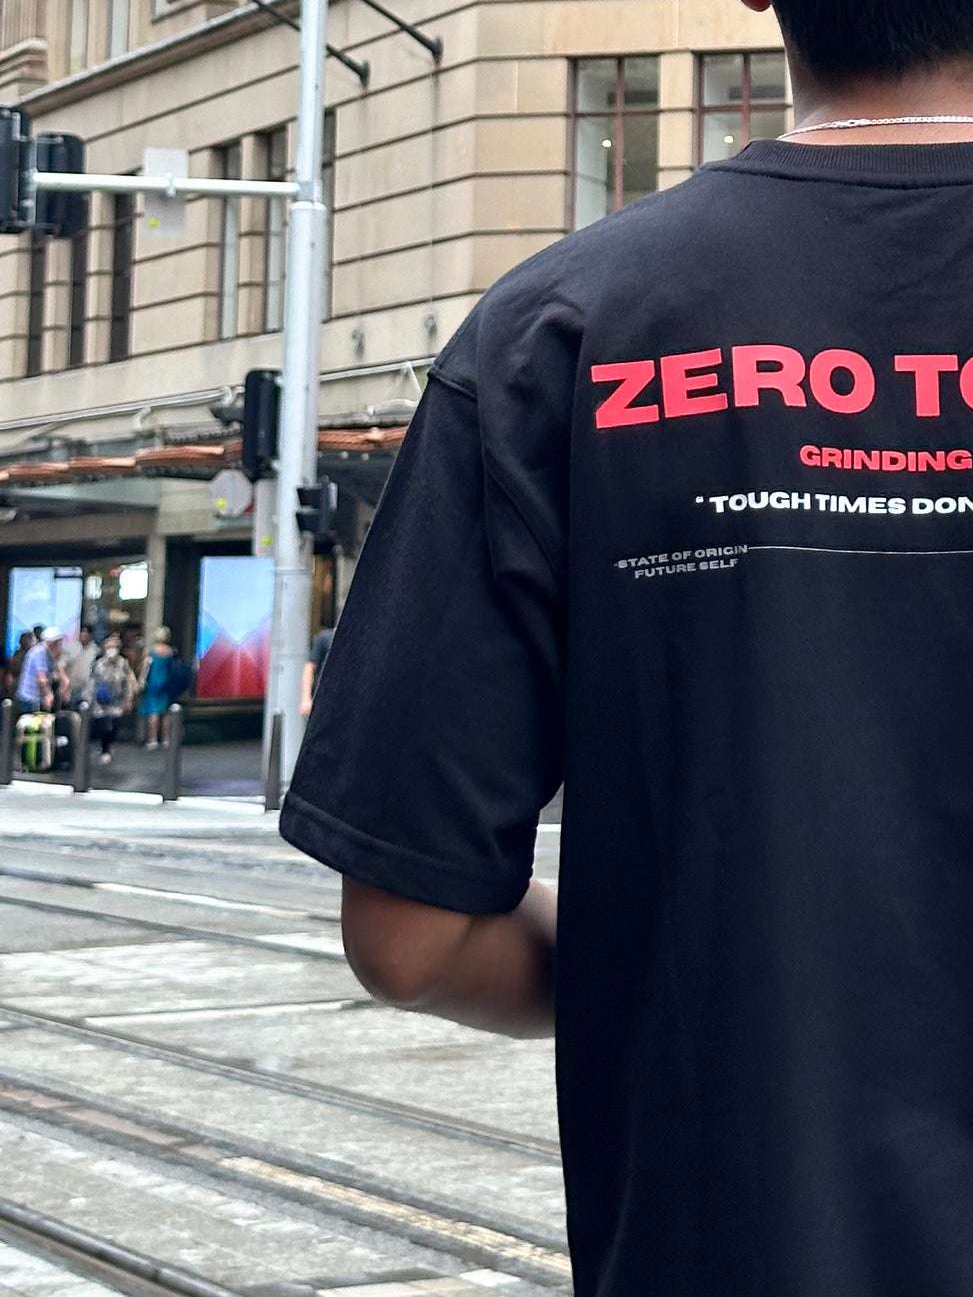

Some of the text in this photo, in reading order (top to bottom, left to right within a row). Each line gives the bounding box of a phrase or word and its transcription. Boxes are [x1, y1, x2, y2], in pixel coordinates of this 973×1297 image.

[590, 344, 876, 429] ZERO
[799, 444, 973, 472] GRINDING
[814, 493, 907, 514] TIMES
[671, 550, 692, 561] OF
[694, 544, 749, 559] ORIGIN
[634, 558, 739, 579] FUTURE SELF
